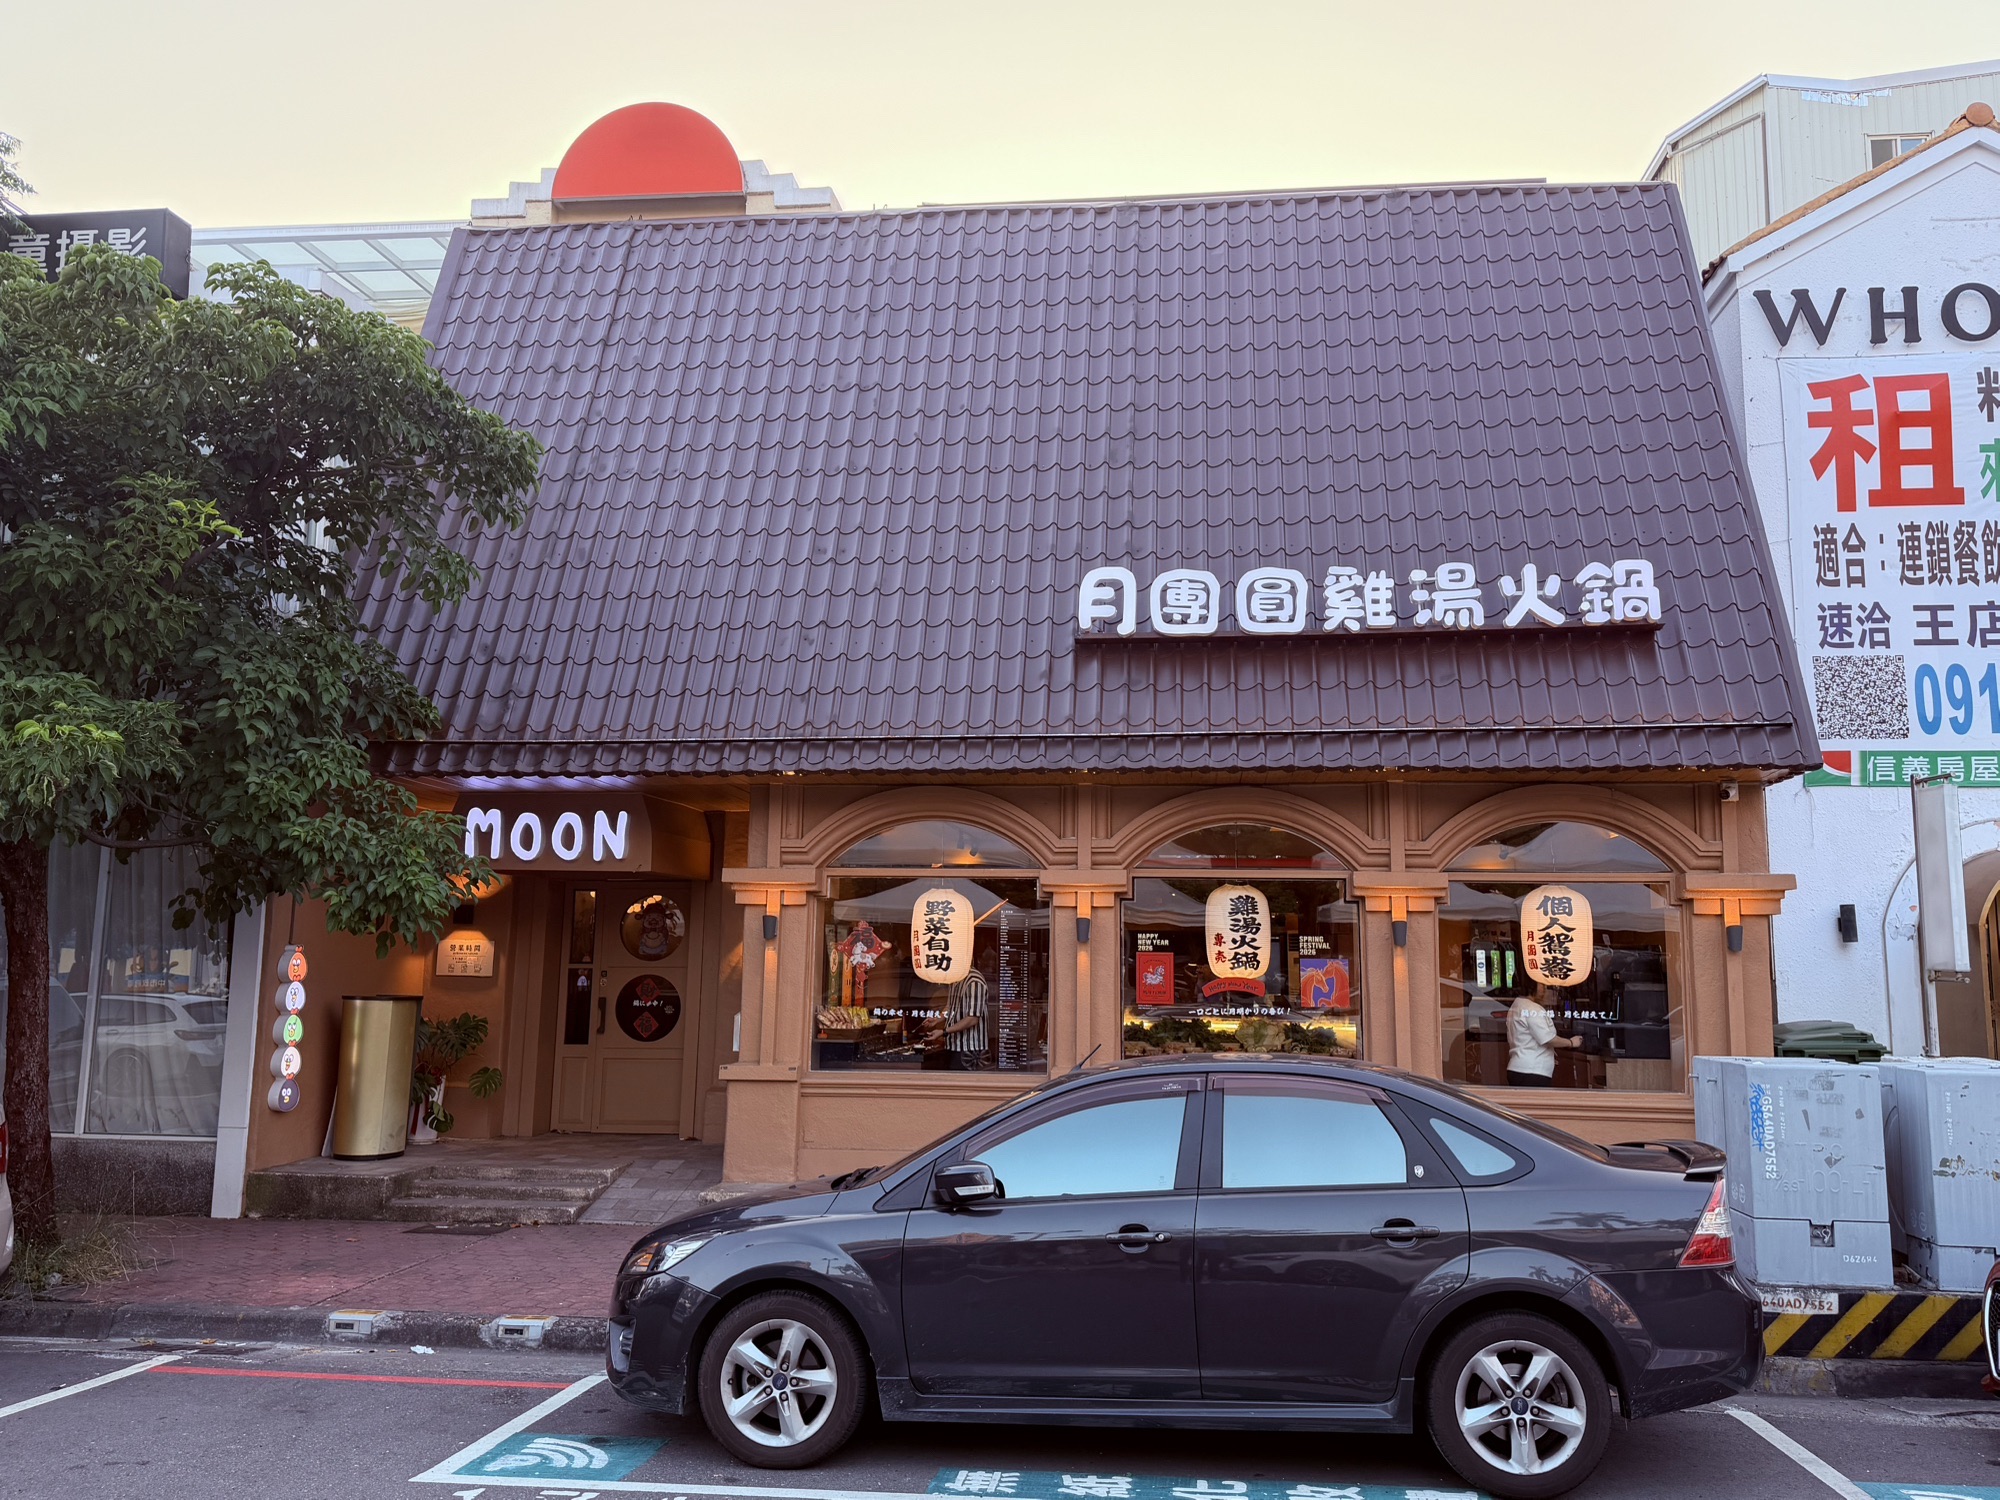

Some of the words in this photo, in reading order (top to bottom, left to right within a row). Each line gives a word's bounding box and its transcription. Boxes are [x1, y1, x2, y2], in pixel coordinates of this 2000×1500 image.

[1753, 282, 2000, 348] WHO
[1807, 373, 1965, 513] 租
[1078, 558, 1662, 637] 月團圓雞湯火鍋
[1817, 601, 1892, 650] 速洽
[1912, 600, 2000, 649] 王店
[1914, 662, 2000, 736] 091
[1867, 755, 2000, 783] 信義房屋
[464, 806, 629, 862] MOON
[922, 899, 956, 973] 野菜自助
[1227, 894, 1262, 971] 雞湯火鍋
[1299, 935, 1324, 943] SPRING
[1299, 942, 1331, 950] FESTIVAL
[1299, 948, 1316, 956] 2026
